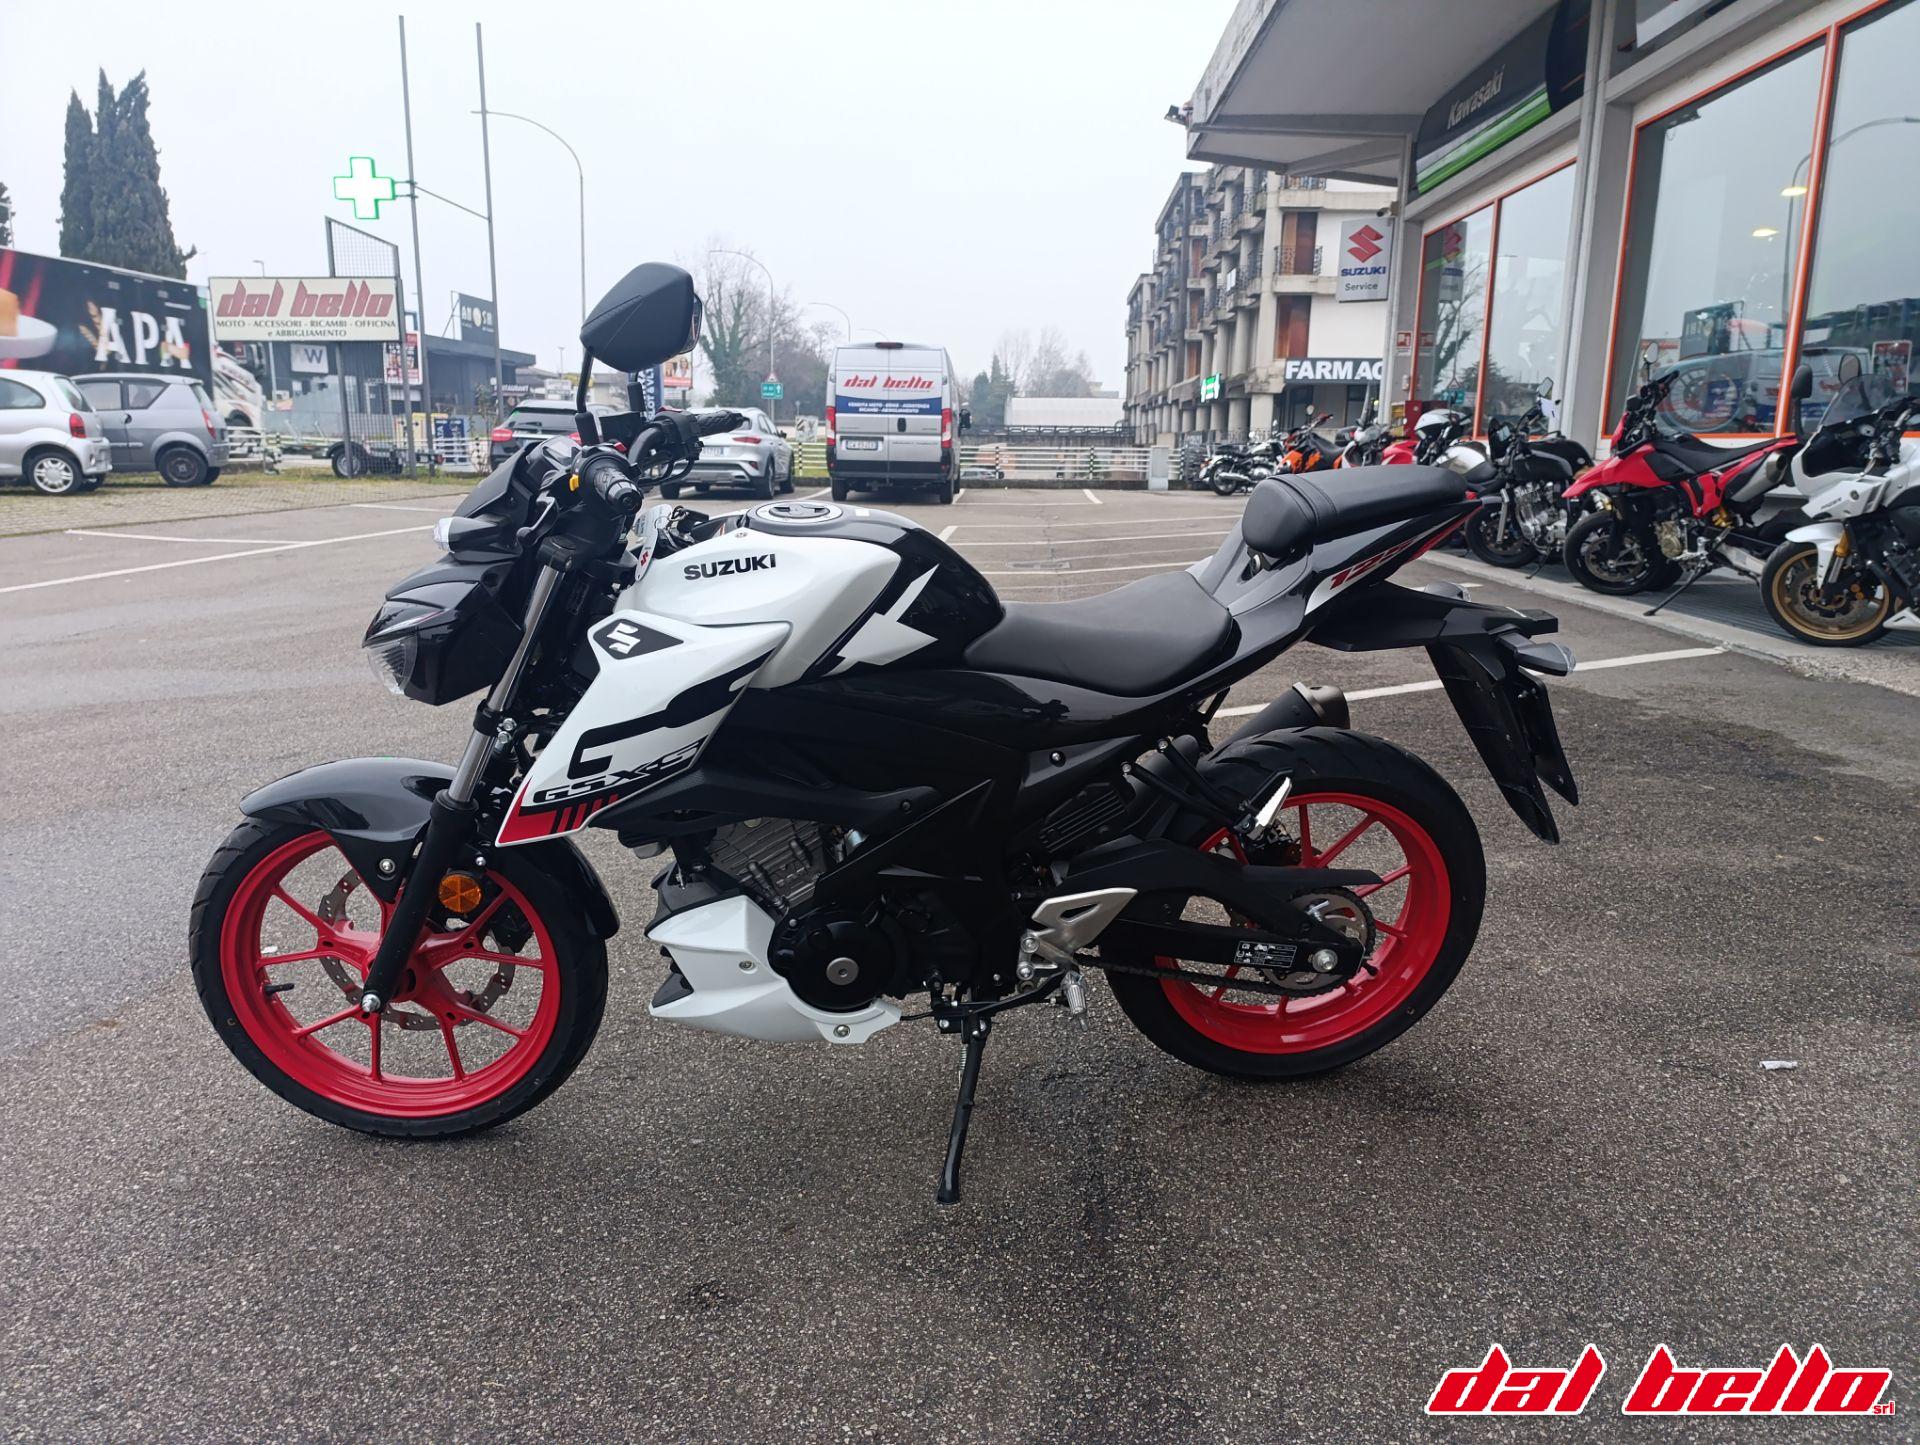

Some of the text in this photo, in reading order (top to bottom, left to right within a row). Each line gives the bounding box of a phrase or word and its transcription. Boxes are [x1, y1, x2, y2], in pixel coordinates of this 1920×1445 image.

[1446, 63, 1506, 131] Kawasaki
[1340, 266, 1387, 277] SUZUKI
[1344, 282, 1379, 292] Service
[216, 279, 395, 318] dal bello
[216, 319, 246, 328] MOTO
[253, 319, 302, 328] ACCESSORI
[309, 319, 347, 328] RICAMBI
[354, 319, 396, 328] OFFICINA
[274, 329, 347, 337] ABBIGLIAMENTO
[303, 349, 323, 364] W
[843, 375, 934, 389] dal bello
[683, 553, 777, 581] SUZUKI
